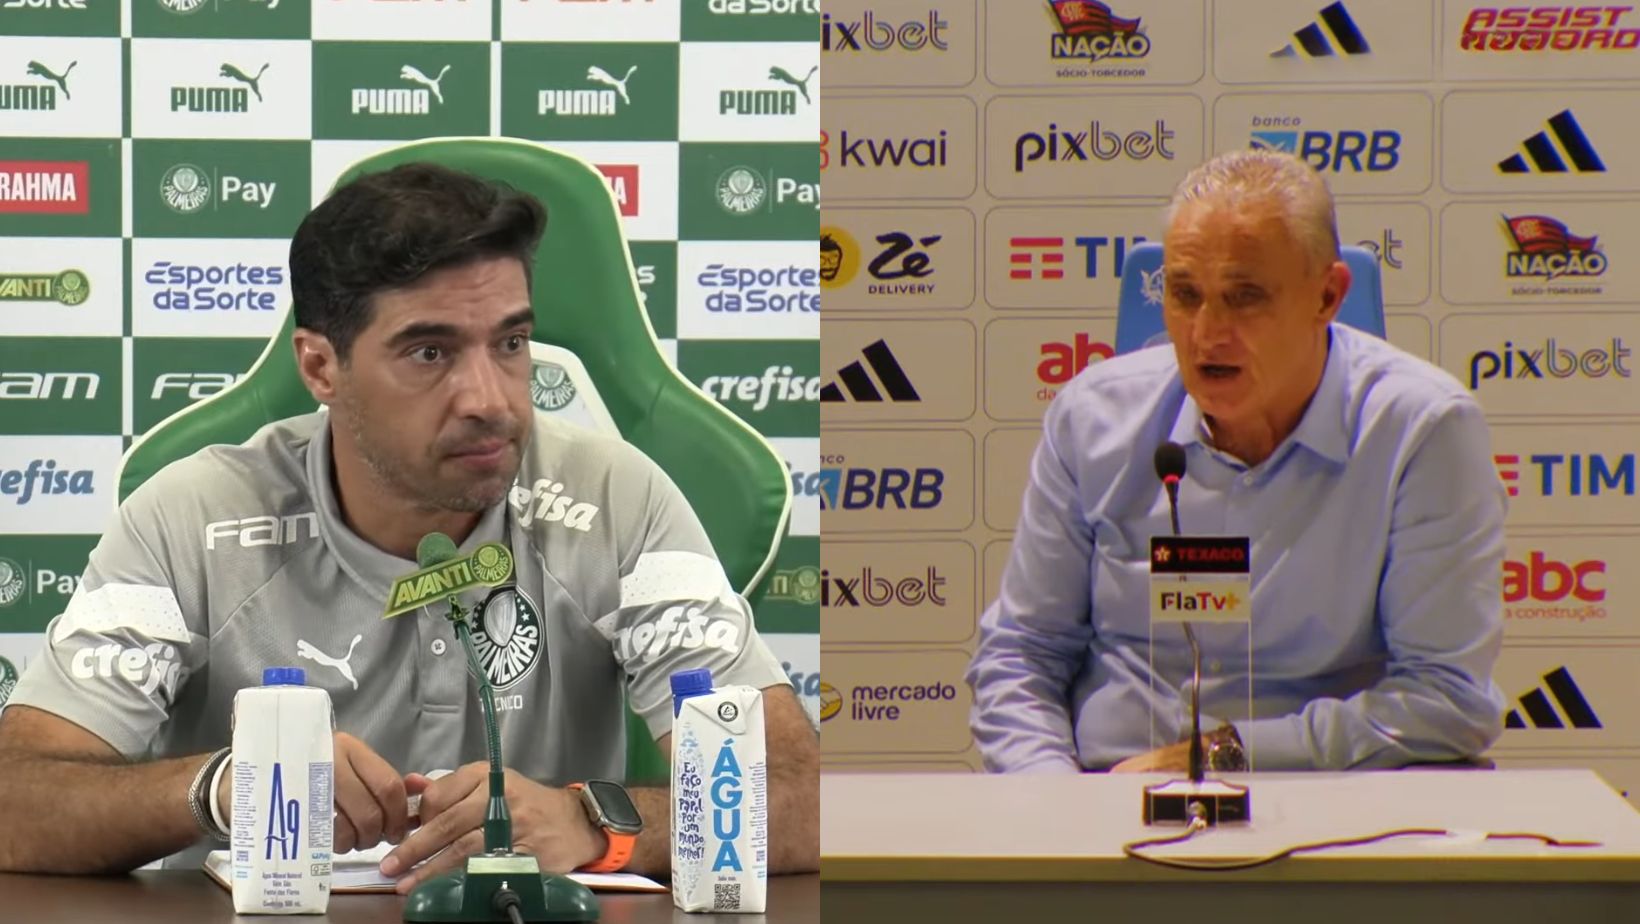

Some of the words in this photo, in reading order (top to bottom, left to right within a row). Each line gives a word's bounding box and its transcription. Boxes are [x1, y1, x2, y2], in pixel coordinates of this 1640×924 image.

[1463, 6, 1633, 31] ASSIST
[1053, 32, 1150, 61] NAÇÃO
[171, 87, 248, 112] PUMA
[352, 89, 430, 115] PUMA
[538, 90, 616, 115] PUMA
[720, 90, 797, 115] PUMA
[1252, 116, 1302, 126] banco
[840, 130, 947, 167] kwai
[1015, 120, 1175, 172] pixbet
[1301, 130, 1402, 172] BRB
[221, 177, 276, 208] Pay
[868, 232, 942, 280] Zé
[1508, 250, 1607, 281] NAÇÃO
[145, 262, 283, 289] Esportes
[697, 264, 820, 292] Esporte
[868, 284, 935, 294] DELIVERY
[1470, 338, 1631, 390] pixbet
[151, 373, 249, 399] Fa
[0, 460, 95, 505] efisa
[842, 468, 944, 510] BRB
[1531, 454, 1635, 496] TIM
[508, 478, 600, 532] efisa
[1177, 547, 1245, 562] TEXACO
[394, 562, 472, 608] AVANTI
[474, 556, 510, 582] PALMEIRAS
[480, 695, 523, 712] TCNICO
[852, 682, 956, 701] mercado
[852, 702, 900, 720] livre
[265, 762, 300, 860] A9
[711, 738, 743, 871] ÁGUA
